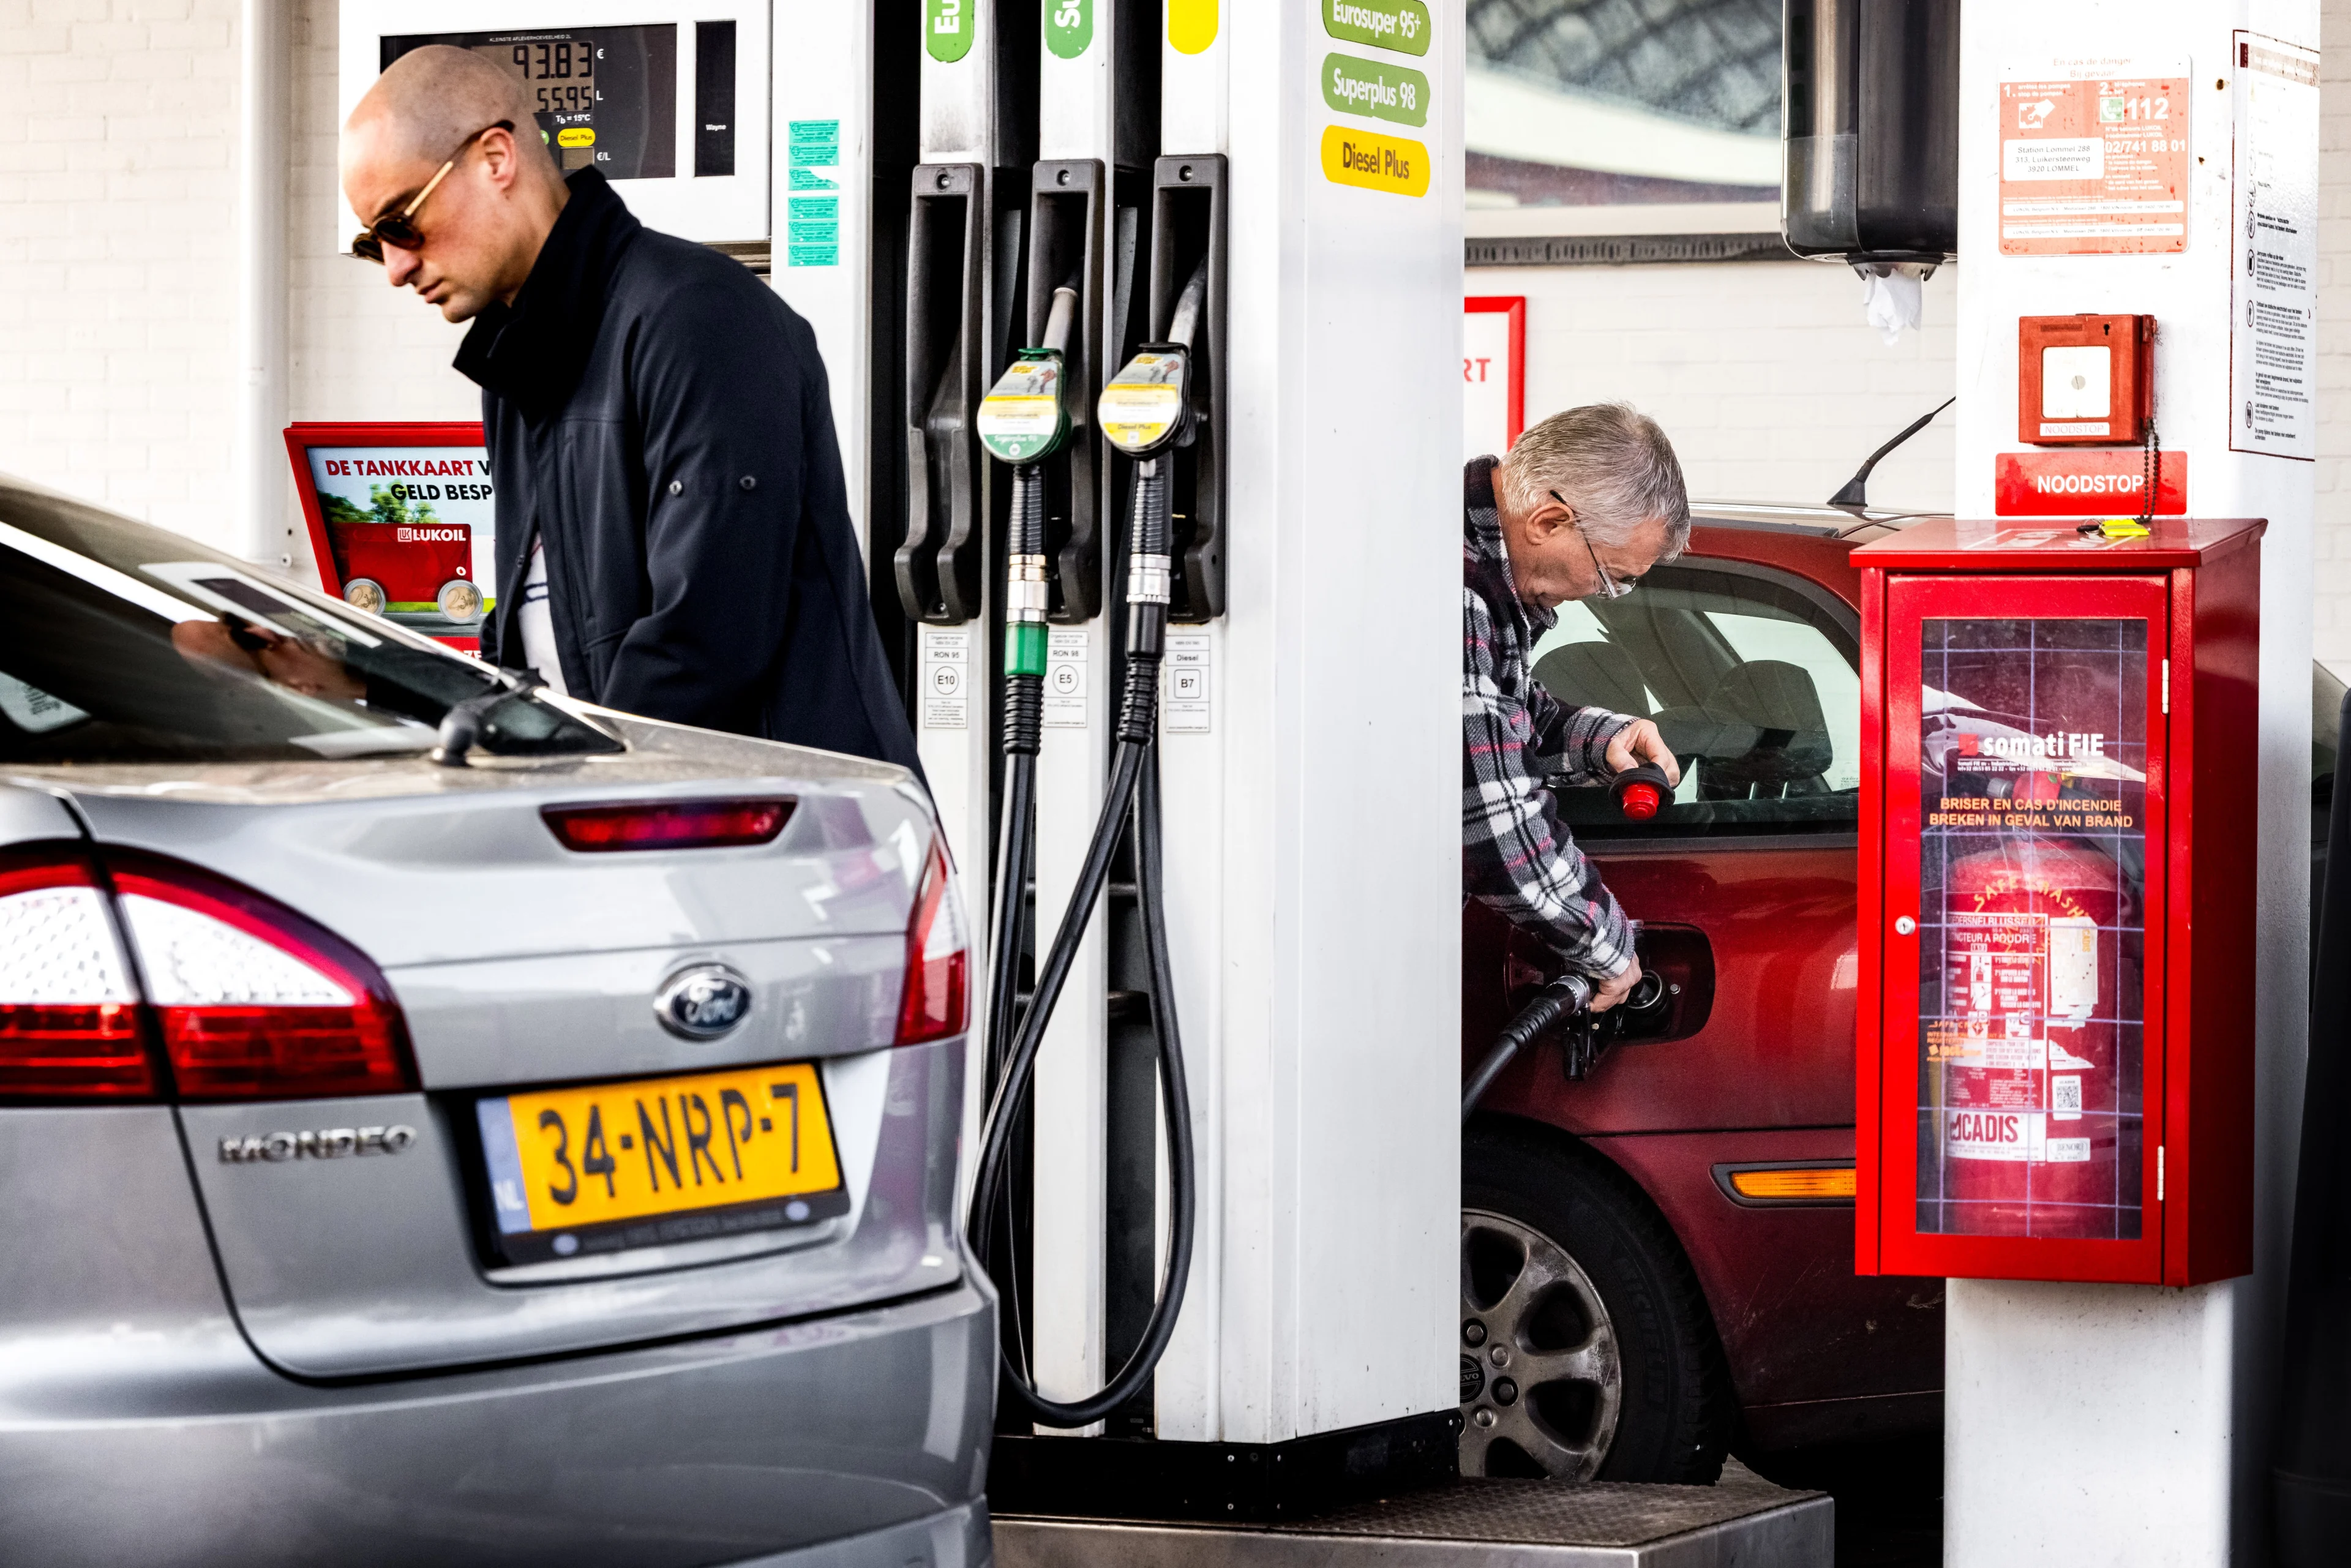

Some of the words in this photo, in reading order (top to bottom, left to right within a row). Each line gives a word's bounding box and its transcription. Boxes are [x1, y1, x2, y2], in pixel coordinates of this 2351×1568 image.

[1333, 0, 1397, 38] Eurosuper
[596, 48, 604, 59] €
[596, 90, 603, 100] L
[1333, 67, 1397, 110] Superplus
[1400, 81, 1415, 110] 98
[2127, 97, 2169, 120] 112
[2105, 140, 2146, 153] 02/741
[2151, 140, 2167, 152] 88
[2170, 139, 2186, 151] 01
[1343, 141, 1380, 174] Diesel
[1385, 149, 1409, 179] Plus
[2045, 424, 2104, 434] NOODSTOP
[325, 460, 351, 476] DE
[353, 460, 473, 476] TANKKAART
[391, 483, 441, 501] GELD
[444, 483, 493, 501] BESP
[2037, 475, 2144, 494] NOODSTOP
[412, 528, 467, 542] LUKOIL
[938, 675, 955, 685] E10
[1060, 674, 1072, 683] E5
[1181, 678, 1194, 688] B7
[1983, 731, 2064, 757] somati
[2068, 733, 2104, 757] FIE
[1940, 798, 1990, 811] BRISER
[1993, 798, 2011, 811] EN
[2014, 798, 2043, 811] CAS
[2046, 798, 2122, 812] D'INCENDIE
[1929, 813, 1985, 827] BREKEN
[1988, 813, 2001, 827] IN
[2004, 814, 2050, 827] GEVAL
[2053, 814, 2081, 827] VAN
[2085, 814, 2133, 828] BRAND
[1974, 876, 2019, 912] SAFE
[1993, 933, 2036, 943] POUDRE
[685, 980, 740, 1024] Ford
[217, 1125, 418, 1164] MONDEO
[538, 1082, 800, 1209] 34-NRP-7
[493, 1179, 523, 1212] NL
